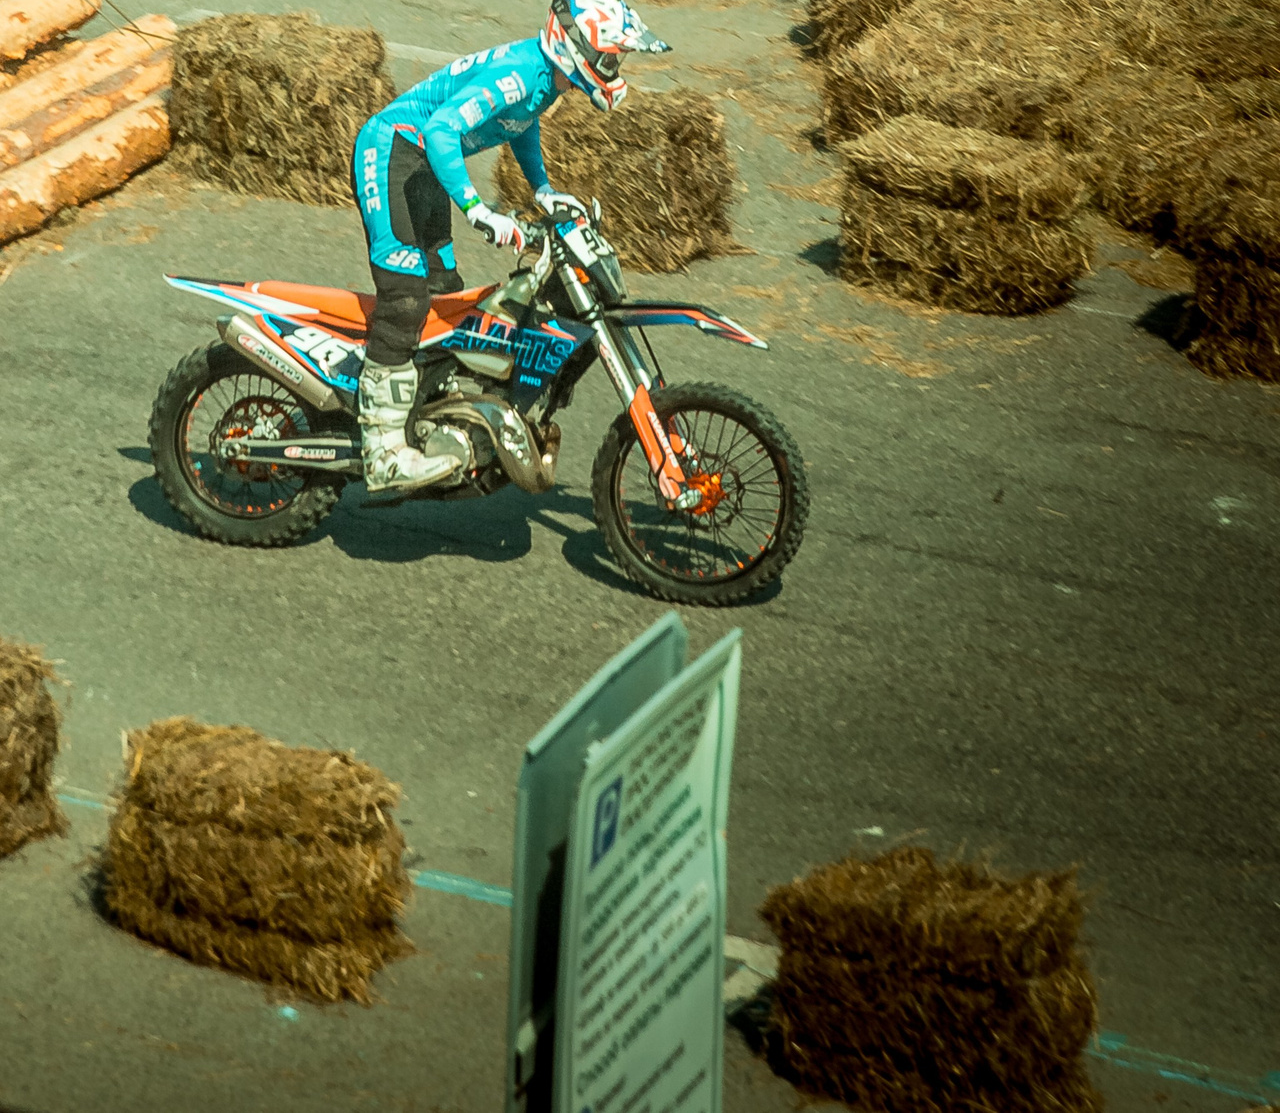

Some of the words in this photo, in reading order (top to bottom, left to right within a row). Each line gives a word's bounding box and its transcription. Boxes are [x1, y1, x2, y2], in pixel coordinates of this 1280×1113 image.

[496, 74, 524, 105] 96
[282, 326, 358, 368] 96
[519, 374, 542, 387] PRO
[647, 410, 679, 469] AVANTIS
